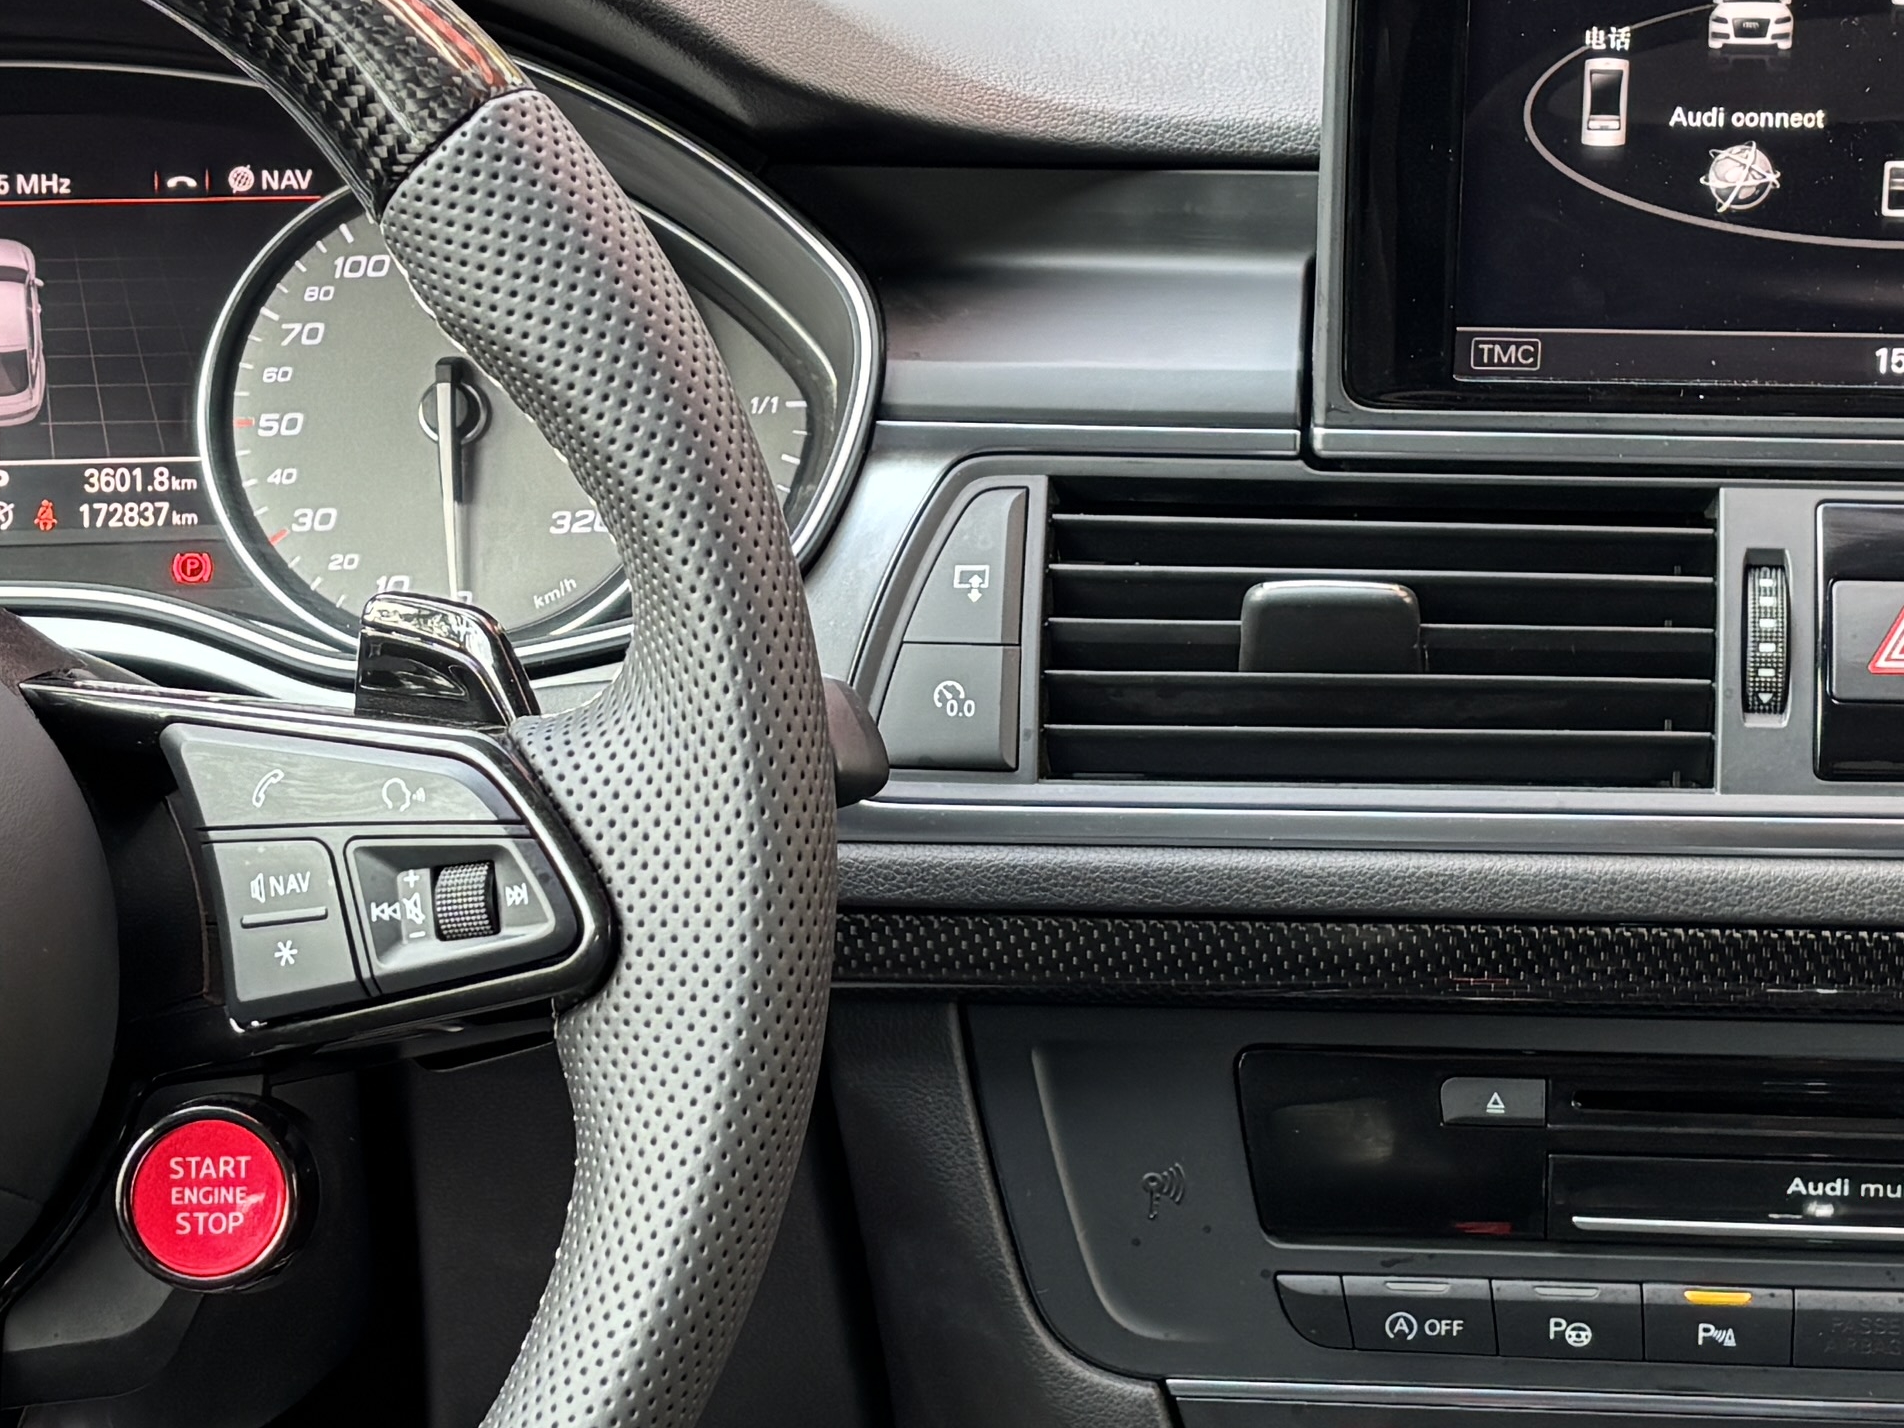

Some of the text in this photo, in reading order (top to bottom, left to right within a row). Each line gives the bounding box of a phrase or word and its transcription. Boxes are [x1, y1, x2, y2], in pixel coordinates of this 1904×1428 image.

[1584, 26, 1632, 52] 电话
[1669, 107, 1826, 130] Audi connect
[15, 173, 71, 196] MHz
[261, 169, 313, 191] NAV
[333, 254, 392, 279] 100
[303, 285, 336, 302] 80
[280, 322, 326, 346] 70
[1477, 342, 1536, 367] TMC
[262, 366, 294, 383] 60
[750, 395, 780, 415] 1/1
[257, 412, 304, 436] 50
[266, 468, 298, 485] 40
[291, 507, 338, 531] 30
[327, 553, 360, 570] 20
[532, 576, 579, 610] km/h
[269, 870, 312, 898] NAV
[168, 1155, 252, 1179] START
[170, 1186, 248, 1205] ENGINE
[1786, 1176, 1850, 1199] Audi
[175, 1211, 245, 1235] STOP
[1423, 1317, 1464, 1338] OFF
